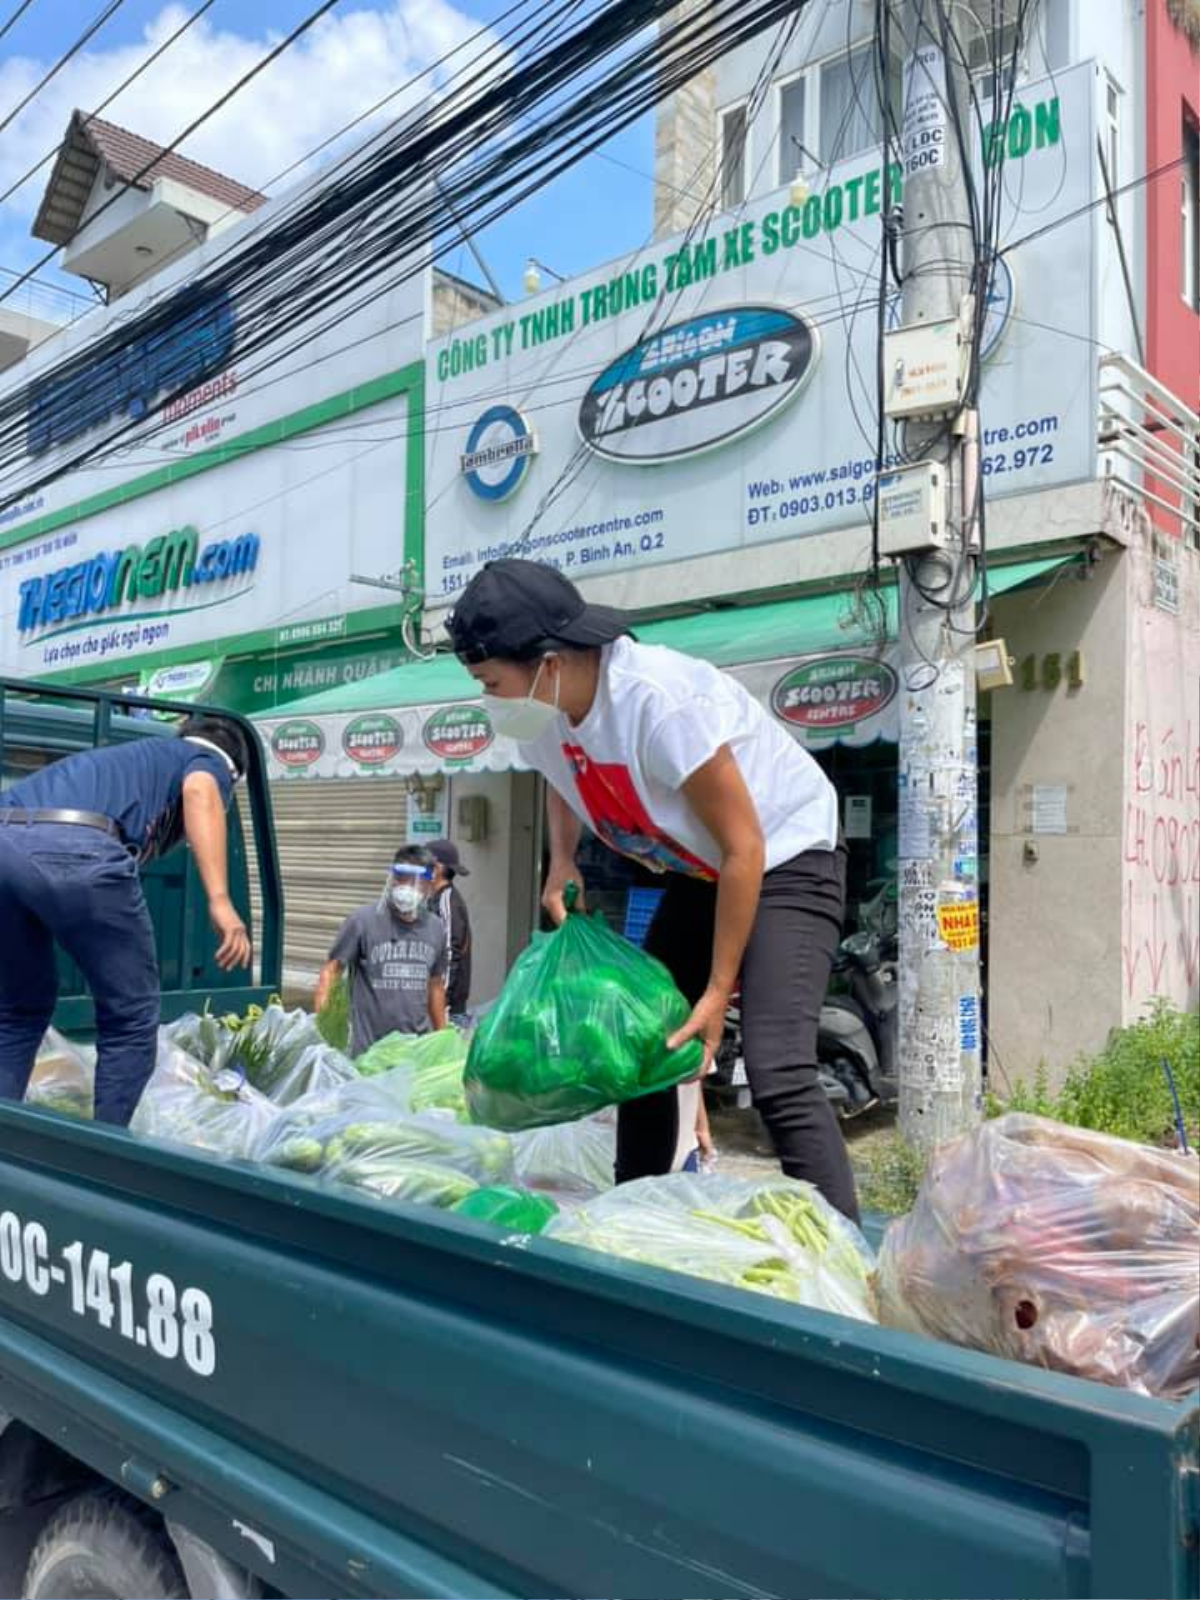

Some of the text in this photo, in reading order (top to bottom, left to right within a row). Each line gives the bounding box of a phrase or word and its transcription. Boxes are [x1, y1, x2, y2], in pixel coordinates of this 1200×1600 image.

[437, 332, 487, 382] CÔNG
[491, 321, 515, 360] TY
[519, 298, 574, 349] TNHH
[579, 264, 658, 325] TRUNG
[663, 236, 717, 293] TÂM
[722, 220, 756, 271] XE
[761, 162, 903, 256] SCOOTER
[594, 340, 794, 435] SCOOTER
[747, 480, 784, 500] Web:
[640, 532, 665, 551] Q.2
[82, 635, 99, 654] cho
[142, 622, 169, 646] ngon
[253, 671, 277, 693] CHI
[784, 678, 881, 708] SCOOTER
[0, 1210, 216, 1377] 0C-141.88
